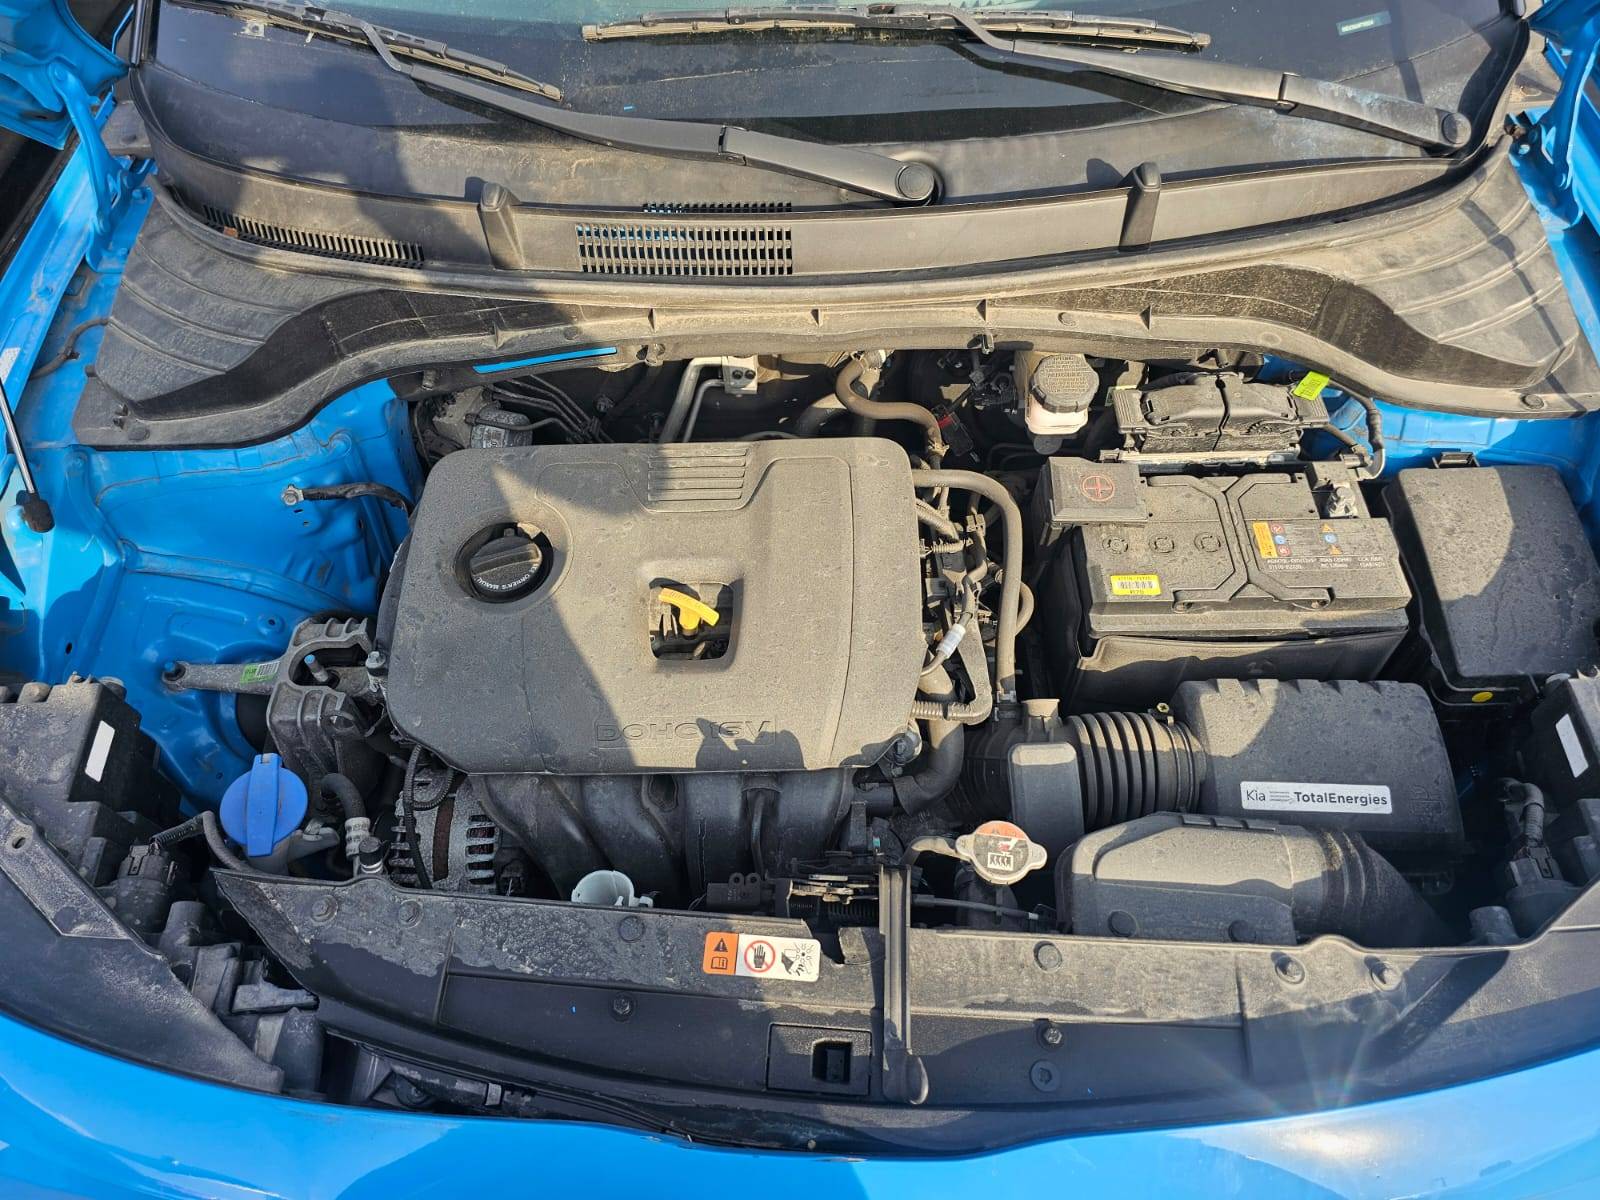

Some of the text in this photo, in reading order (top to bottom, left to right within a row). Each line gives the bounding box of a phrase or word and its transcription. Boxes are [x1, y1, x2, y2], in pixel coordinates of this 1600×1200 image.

[596, 722, 700, 741] DOHC
[1246, 789, 1388, 807] Kia TotalEnergies
